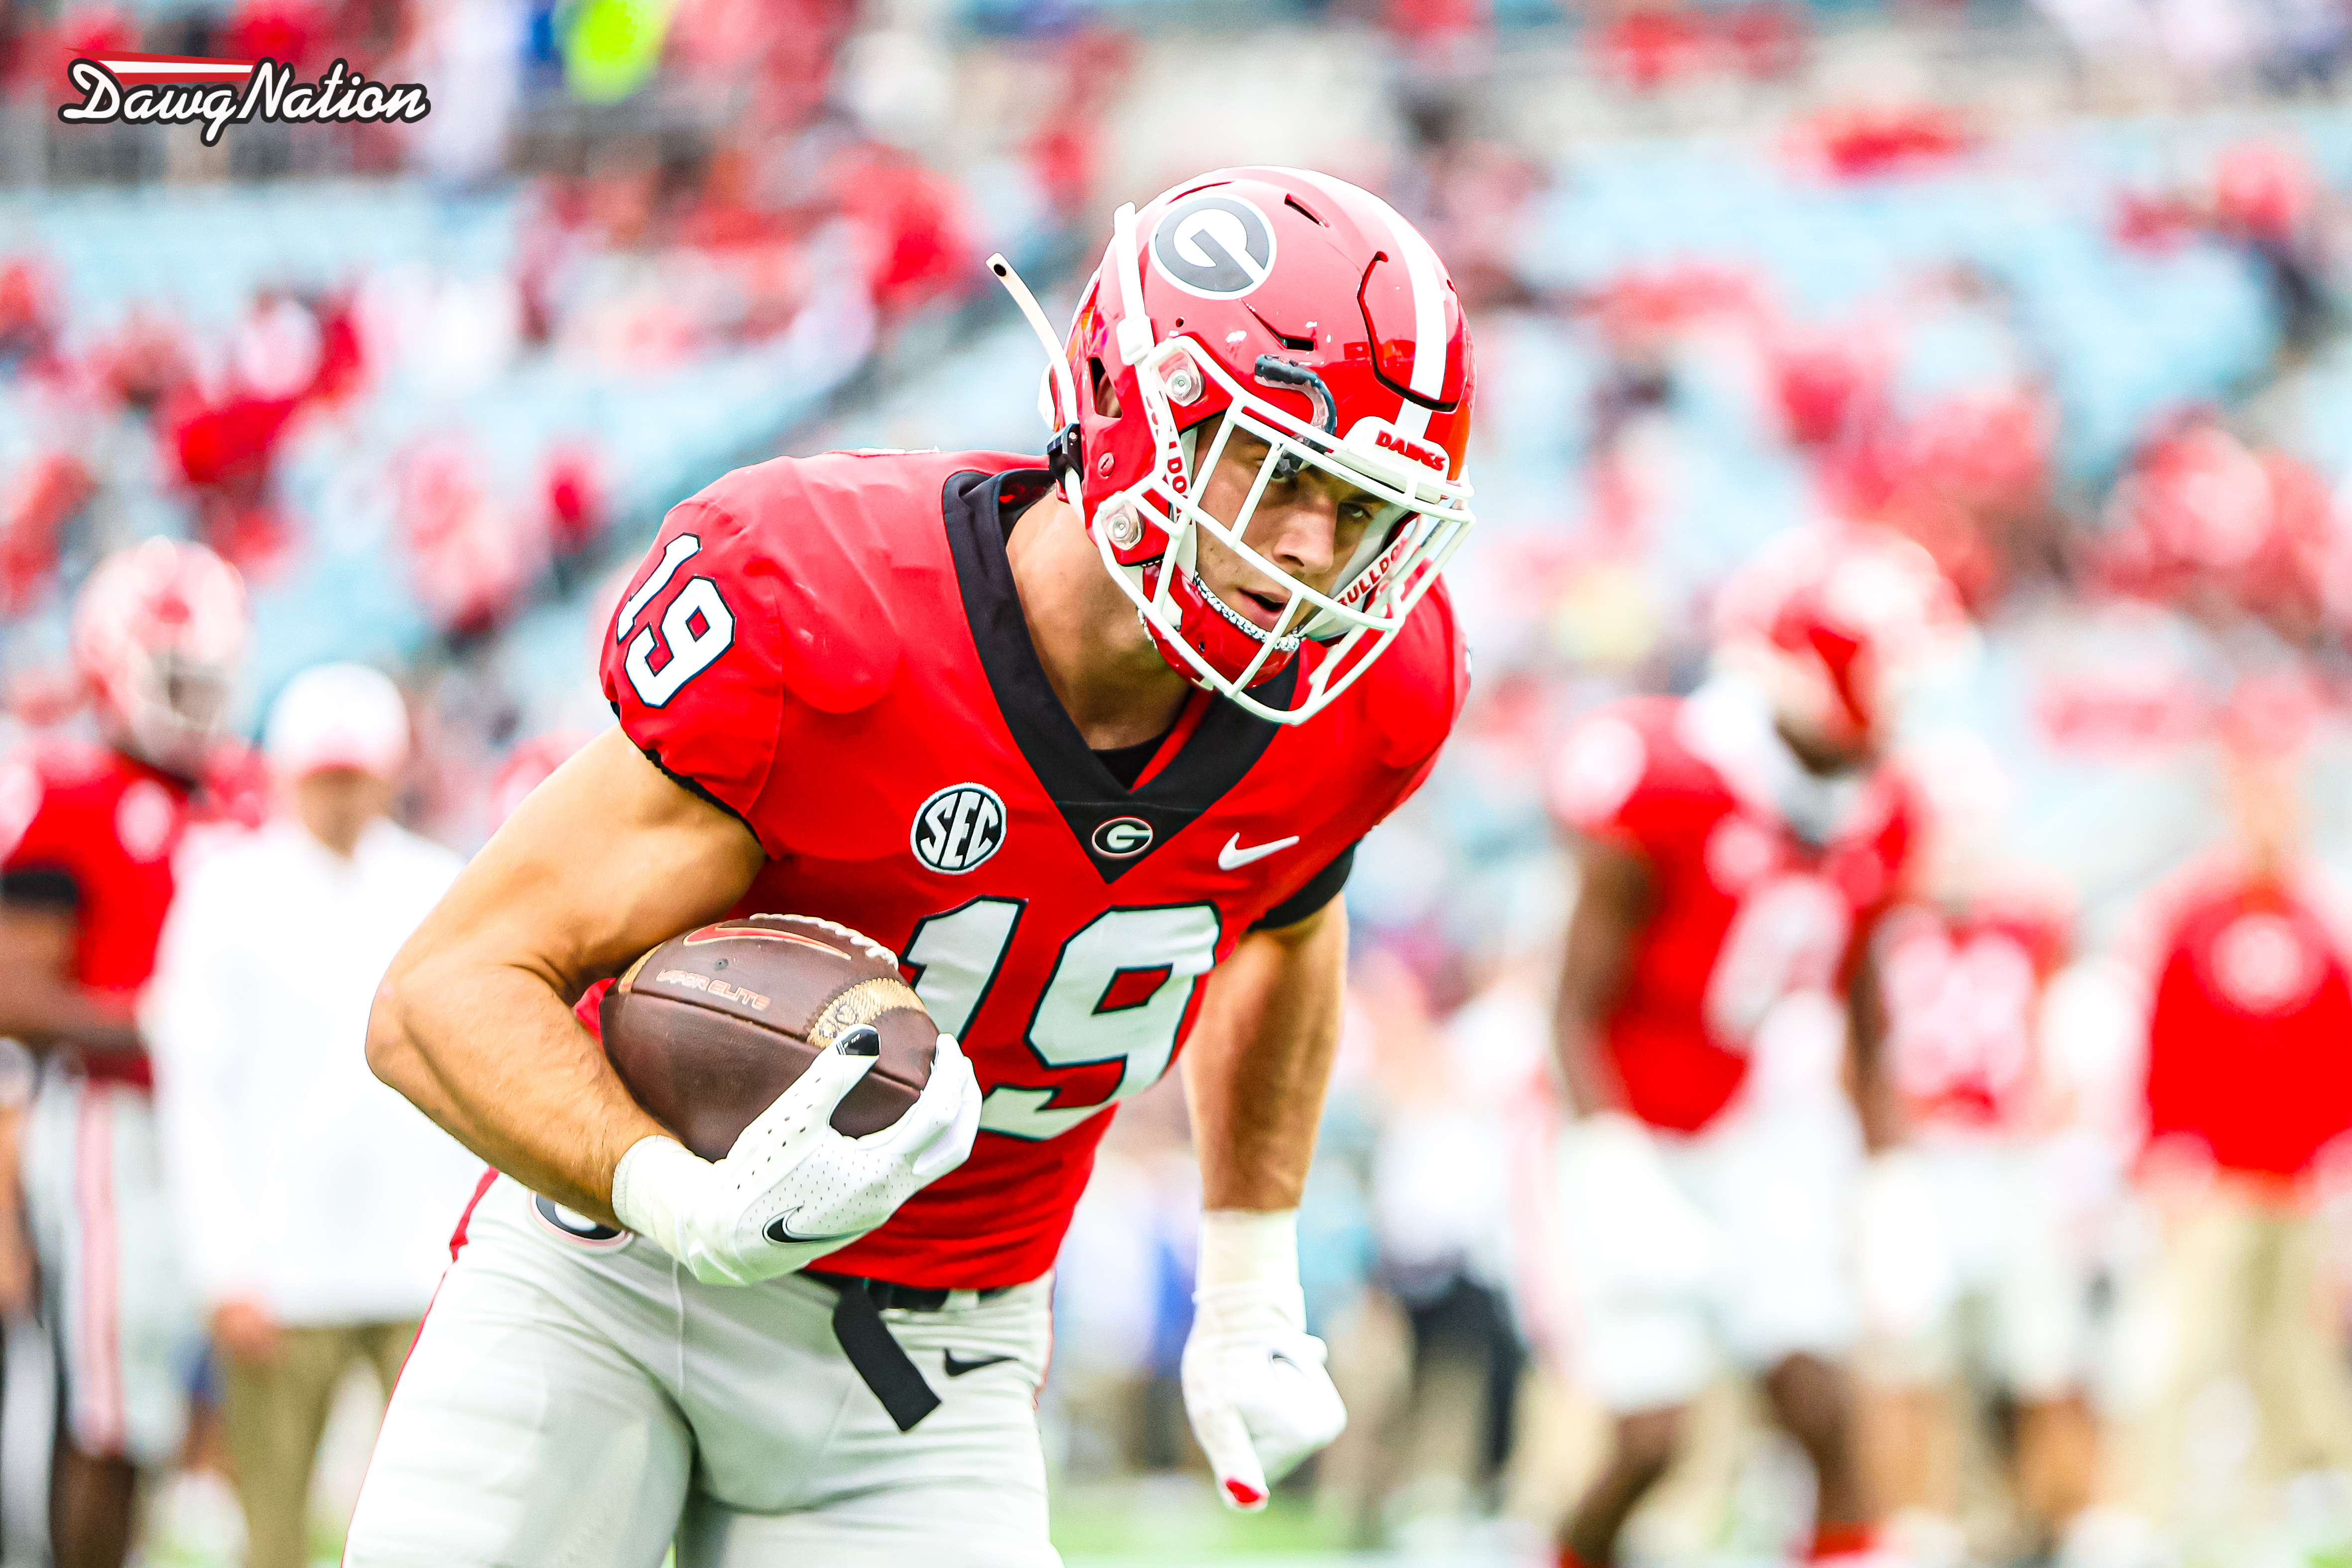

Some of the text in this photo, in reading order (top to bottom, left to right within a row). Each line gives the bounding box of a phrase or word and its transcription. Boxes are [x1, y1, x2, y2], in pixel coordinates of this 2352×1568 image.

[1155, 197, 1270, 292] G
[616, 532, 736, 709] 19
[918, 789, 1000, 869] SEC
[1103, 822, 1154, 853] G
[656, 969, 771, 1011] VAPOR ELITE
[898, 895, 1222, 1141] 19
